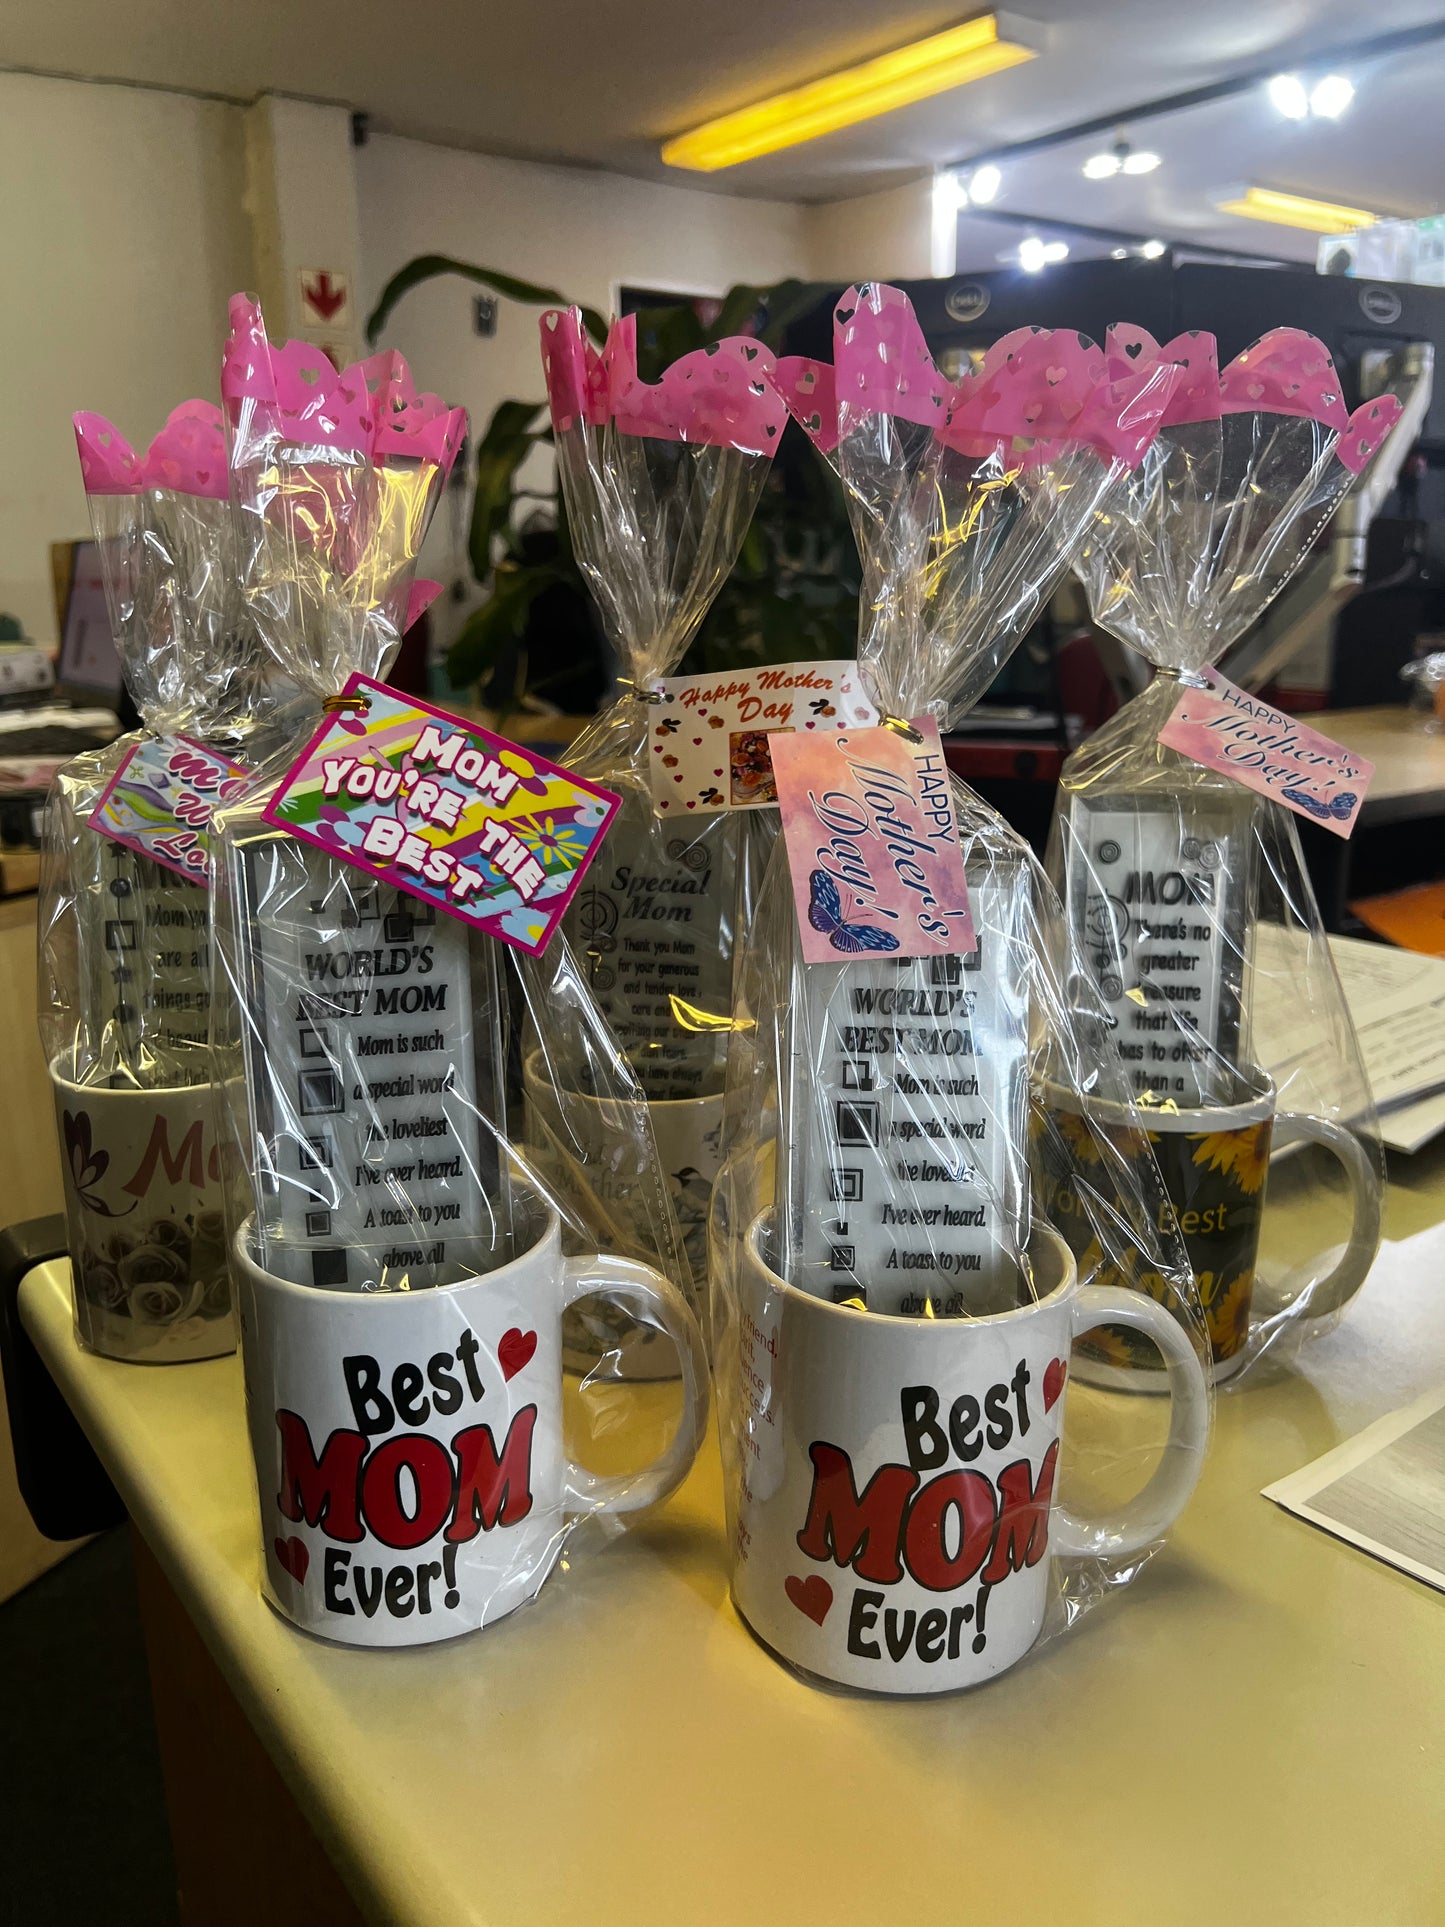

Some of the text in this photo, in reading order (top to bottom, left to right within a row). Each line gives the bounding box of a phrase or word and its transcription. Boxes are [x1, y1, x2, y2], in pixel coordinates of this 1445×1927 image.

[679, 670, 851, 709] Happy Mother's
[737, 696, 794, 724] Day
[1222, 688, 1297, 734] HAPPY
[1181, 712, 1364, 780] Mother's
[1216, 743, 1336, 793] Day!
[914, 754, 955, 843] HAPPY
[363, 816, 485, 898] BEST
[808, 790, 899, 920] Day!
[837, 737, 965, 947] Mother's
[479, 819, 548, 900] THE
[611, 867, 711, 897] Special
[622, 896, 693, 922] Mom
[624, 938, 696, 956] Thank you Mom
[1193, 926, 1212, 942] no
[305, 945, 435, 981] WORLD'S
[618, 958, 700, 979] for your generous
[1141, 955, 1200, 976] greater
[373, 984, 448, 1016] MOM
[624, 981, 640, 995] and
[645, 982, 675, 997] tender
[1135, 1009, 1167, 1031] that
[357, 1029, 444, 1057] Mom is such
[1118, 1039, 1144, 1061] has
[1151, 1040, 1167, 1061] to
[353, 1071, 454, 1103] a special word
[895, 1072, 980, 1097] Mom is such
[1135, 1070, 1184, 1093] than a
[392, 1116, 448, 1140] loveliest
[899, 1117, 948, 1143] special
[355, 1164, 381, 1187] I've
[418, 1155, 463, 1180] heard.
[897, 1160, 919, 1182] the
[364, 1208, 376, 1229] A
[418, 1205, 431, 1223] to
[434, 1203, 460, 1226] you
[881, 1204, 908, 1226] I've
[943, 1204, 987, 1228] heard.
[1158, 1203, 1228, 1236] Best
[383, 1242, 445, 1269] above all
[886, 1248, 981, 1275] A toast to you
[343, 1328, 485, 1435] Best
[901, 1359, 1031, 1471] Best
[276, 1403, 537, 1550] MOM
[797, 1437, 1059, 1592] MOM
[324, 1543, 460, 1618] Ever!
[847, 1585, 991, 1663] Ever!
